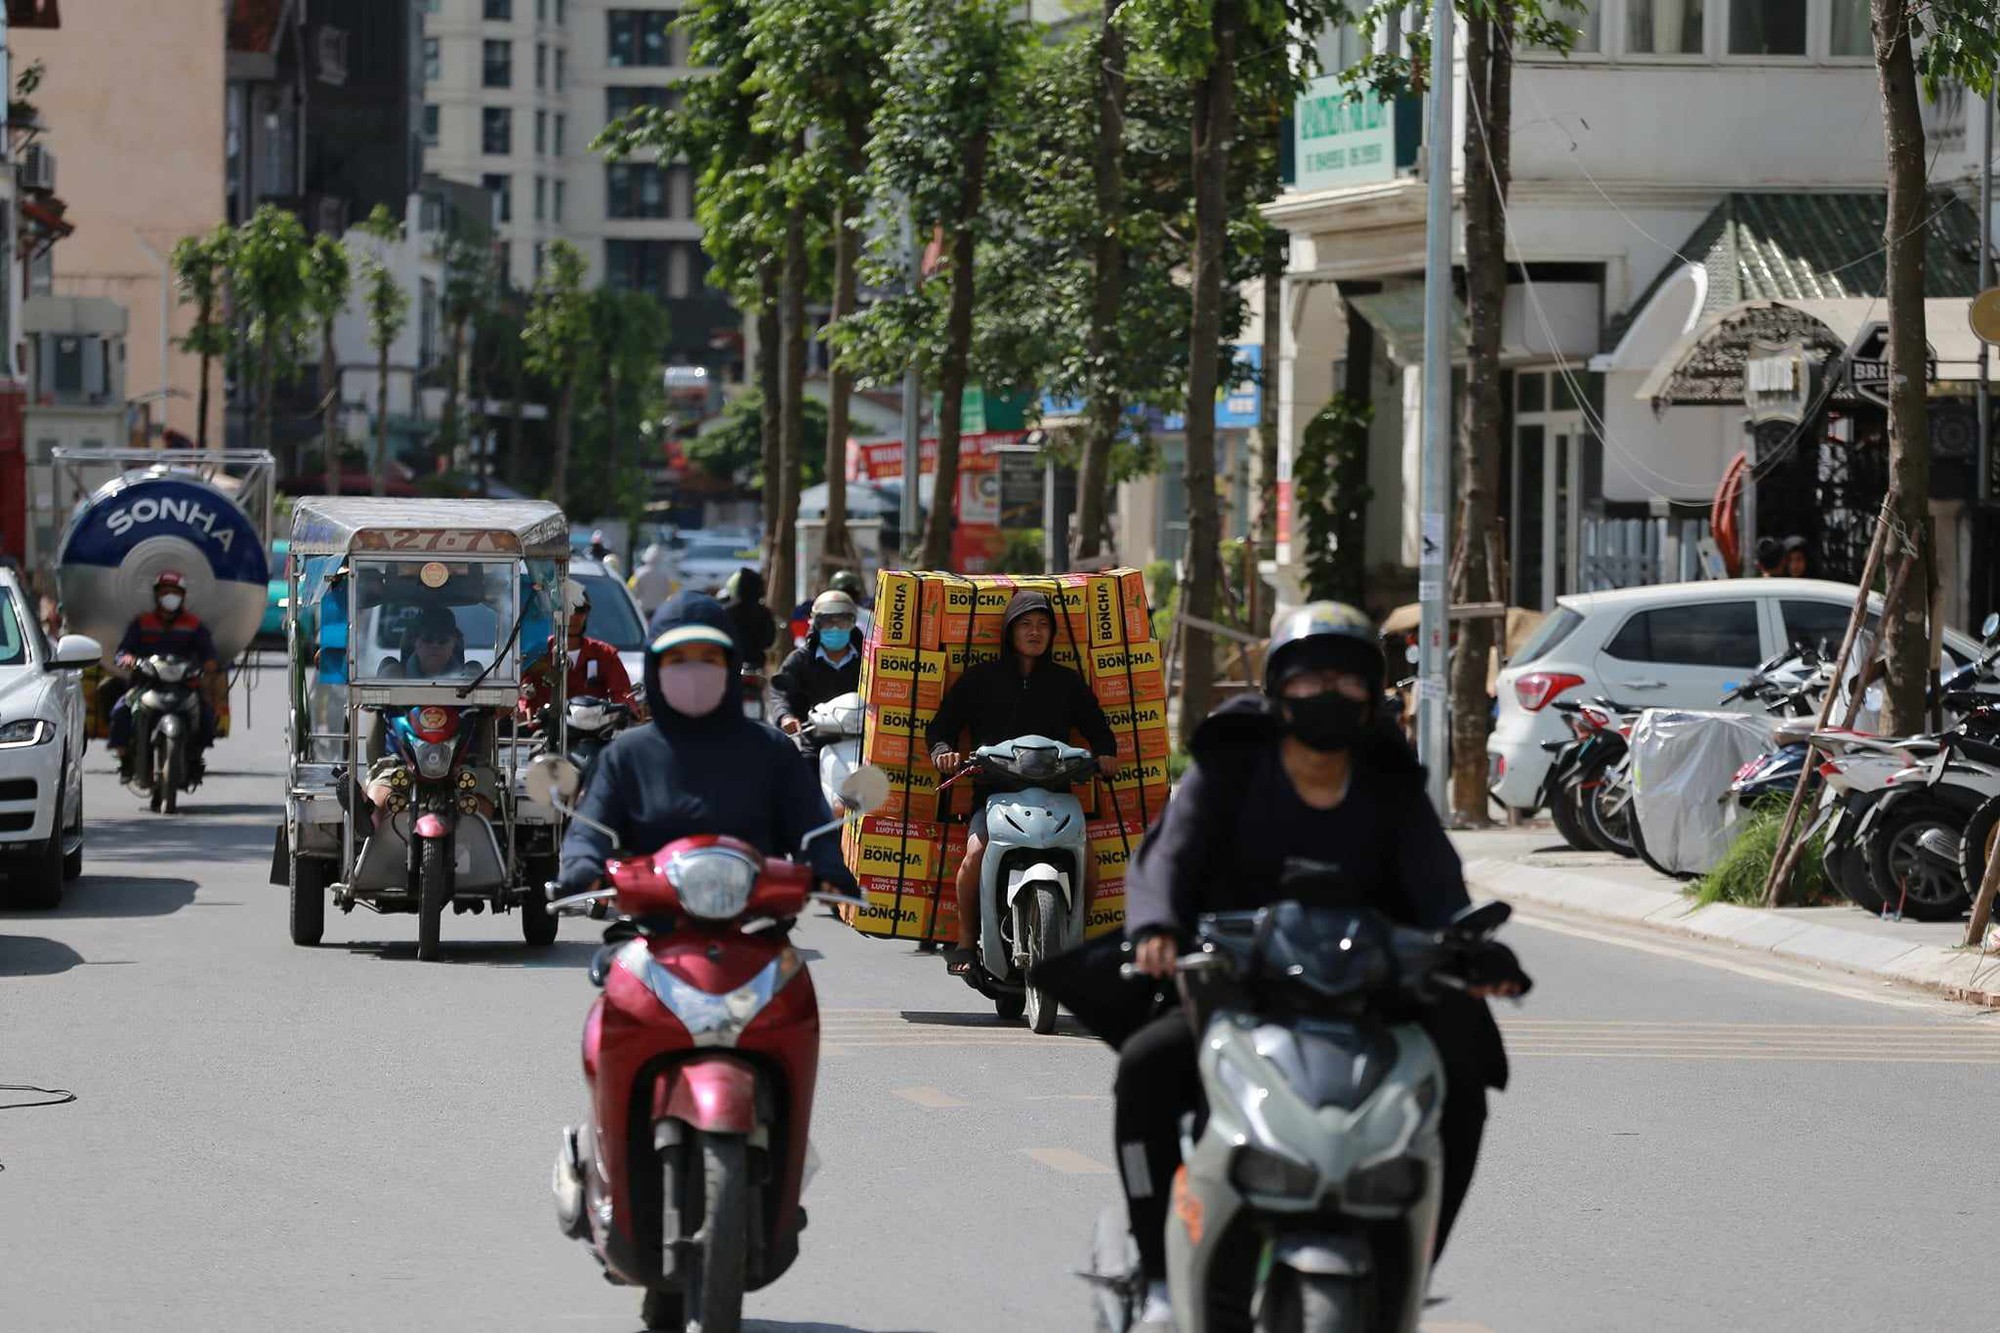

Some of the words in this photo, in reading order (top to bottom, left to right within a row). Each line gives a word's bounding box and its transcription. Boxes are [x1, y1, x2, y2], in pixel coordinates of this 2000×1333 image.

[106, 497, 234, 553] SONHA
[1044, 594, 1081, 606] NCHA
[892, 583, 907, 640] BONCHA
[1097, 583, 1113, 640] BONCHA
[952, 653, 999, 665] BONCH
[883, 714, 930, 731] BONCH
[887, 771, 934, 788] ONCHA
[1110, 765, 1161, 782] ONCHA
[863, 848, 922, 866] BONCHA
[1086, 910, 1126, 926] BONC
